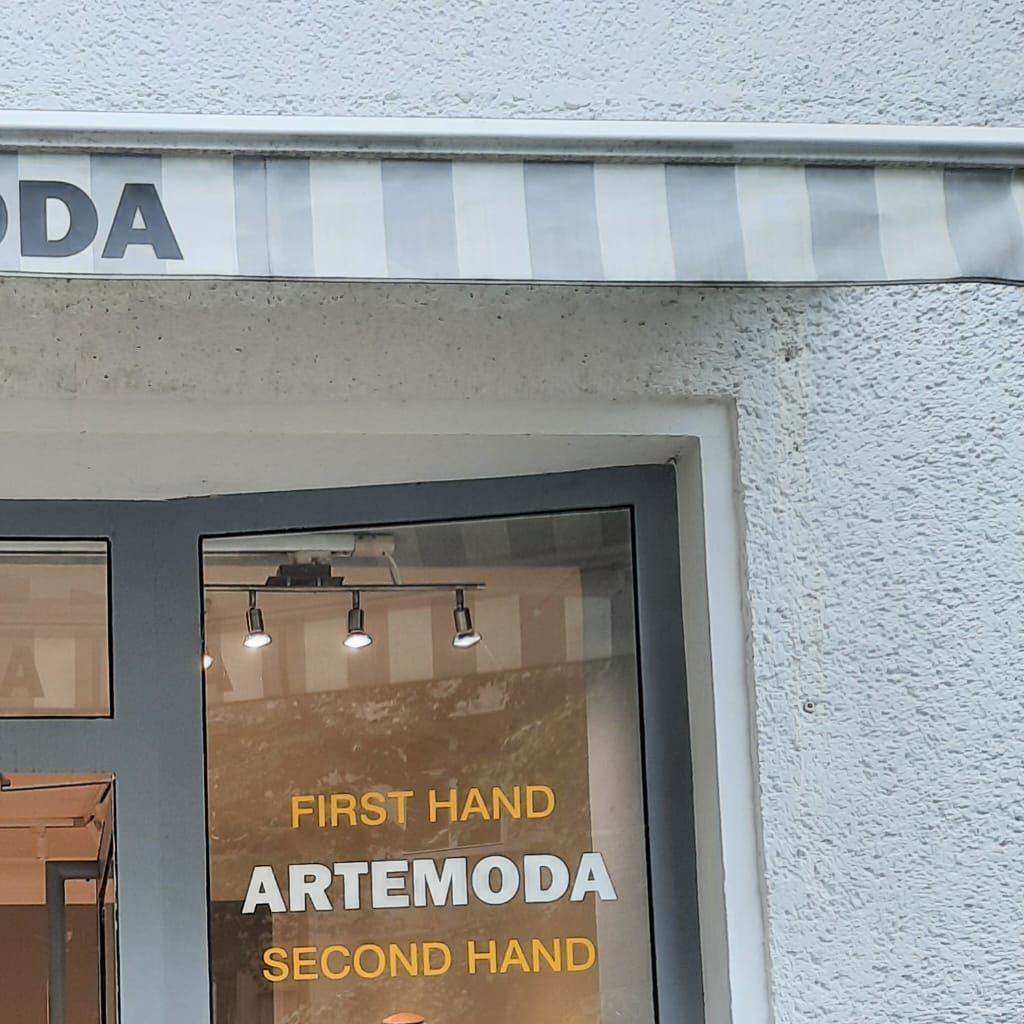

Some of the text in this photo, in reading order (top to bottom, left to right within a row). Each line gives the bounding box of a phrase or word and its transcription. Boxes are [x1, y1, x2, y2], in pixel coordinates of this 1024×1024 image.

[290, 785, 557, 829] FIRST HAND
[241, 852, 618, 915] ARTEMODA
[262, 937, 597, 983] SECOND HAND
